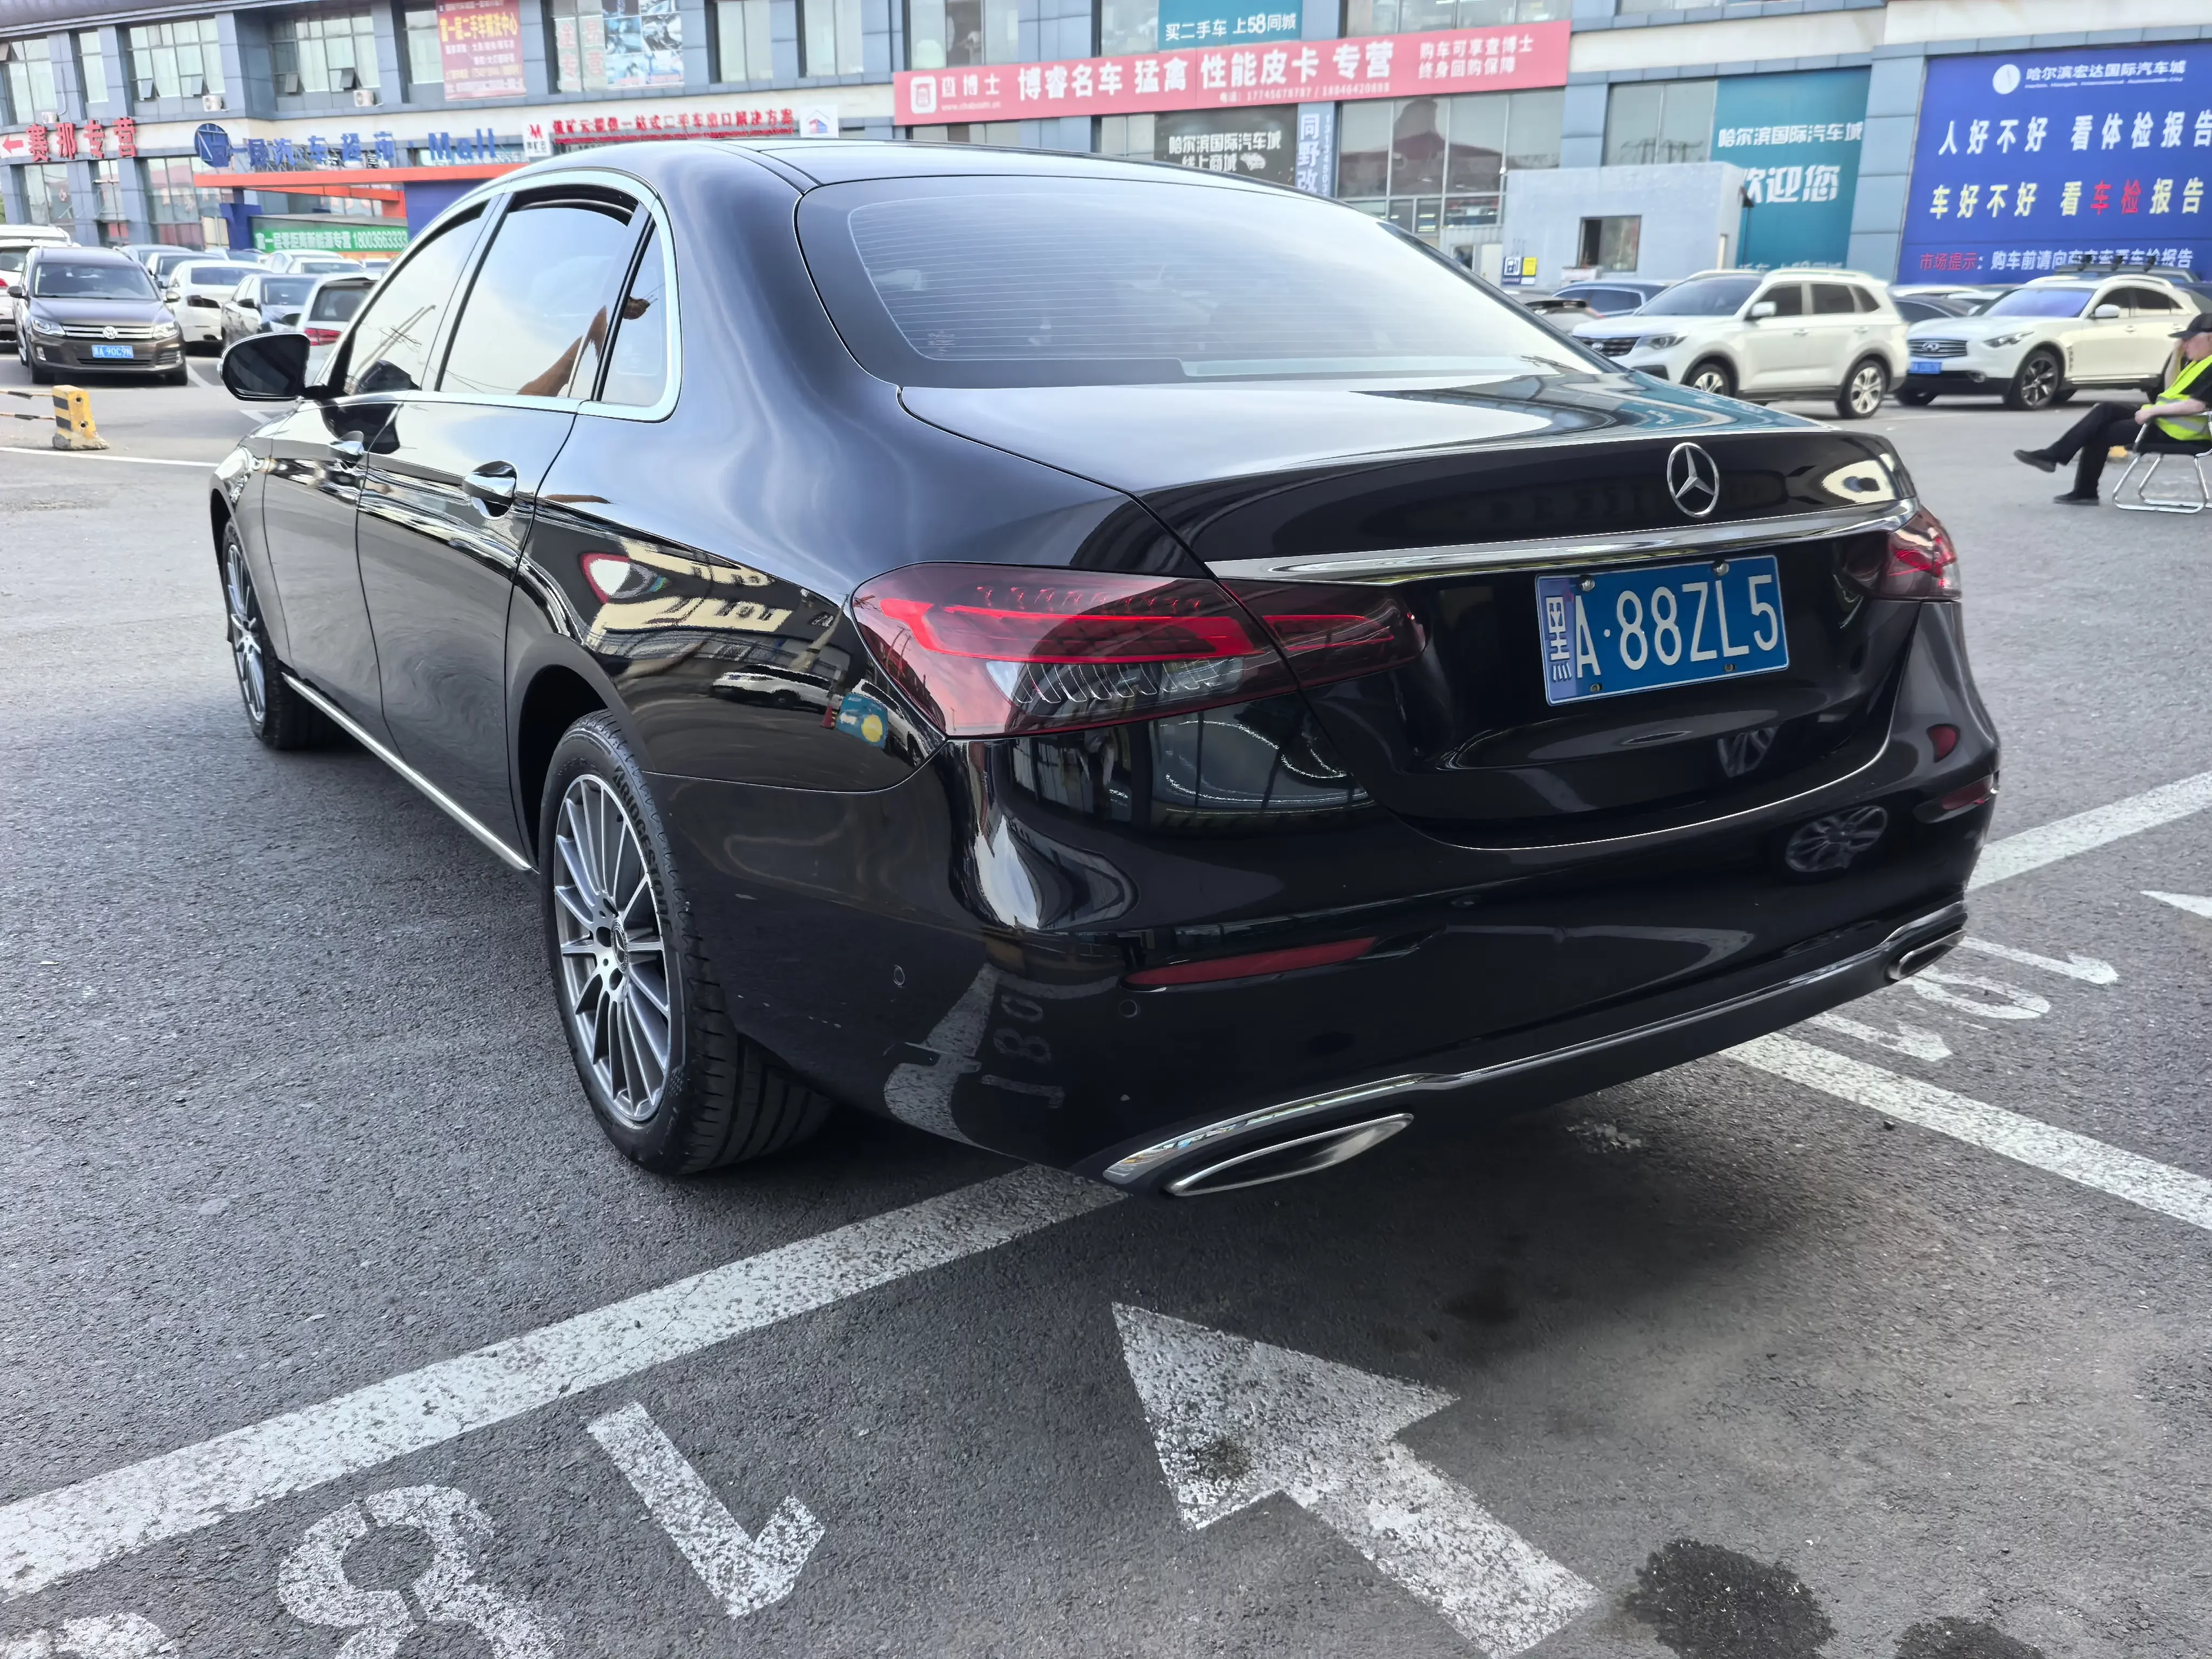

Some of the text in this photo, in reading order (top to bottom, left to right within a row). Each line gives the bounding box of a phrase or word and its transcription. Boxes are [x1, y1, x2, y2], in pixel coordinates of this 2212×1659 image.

[1165, 12, 1297, 41] 买二手车 上58同城
[1420, 33, 1534, 60] 购车可享查博士
[941, 73, 1000, 97] 查博士
[1018, 41, 1394, 101] 博睿名车 猛禽 性能皮卡 专营
[2026, 60, 2187, 81] 哈尔滨宏达国际汽车城
[26, 116, 138, 163] 赛那专营
[428, 128, 495, 161] Mall
[1169, 131, 1281, 154] 哈尔滨国际汽车城
[1718, 121, 1863, 147] 哈尔滨国际汽车城
[1938, 109, 2212, 156] 人好不好 看体检报告
[1182, 153, 1237, 172] 线上商城
[1930, 177, 2204, 219] 车好不好 看车检报告
[611, 765, 675, 934] BRIDGESTONE
